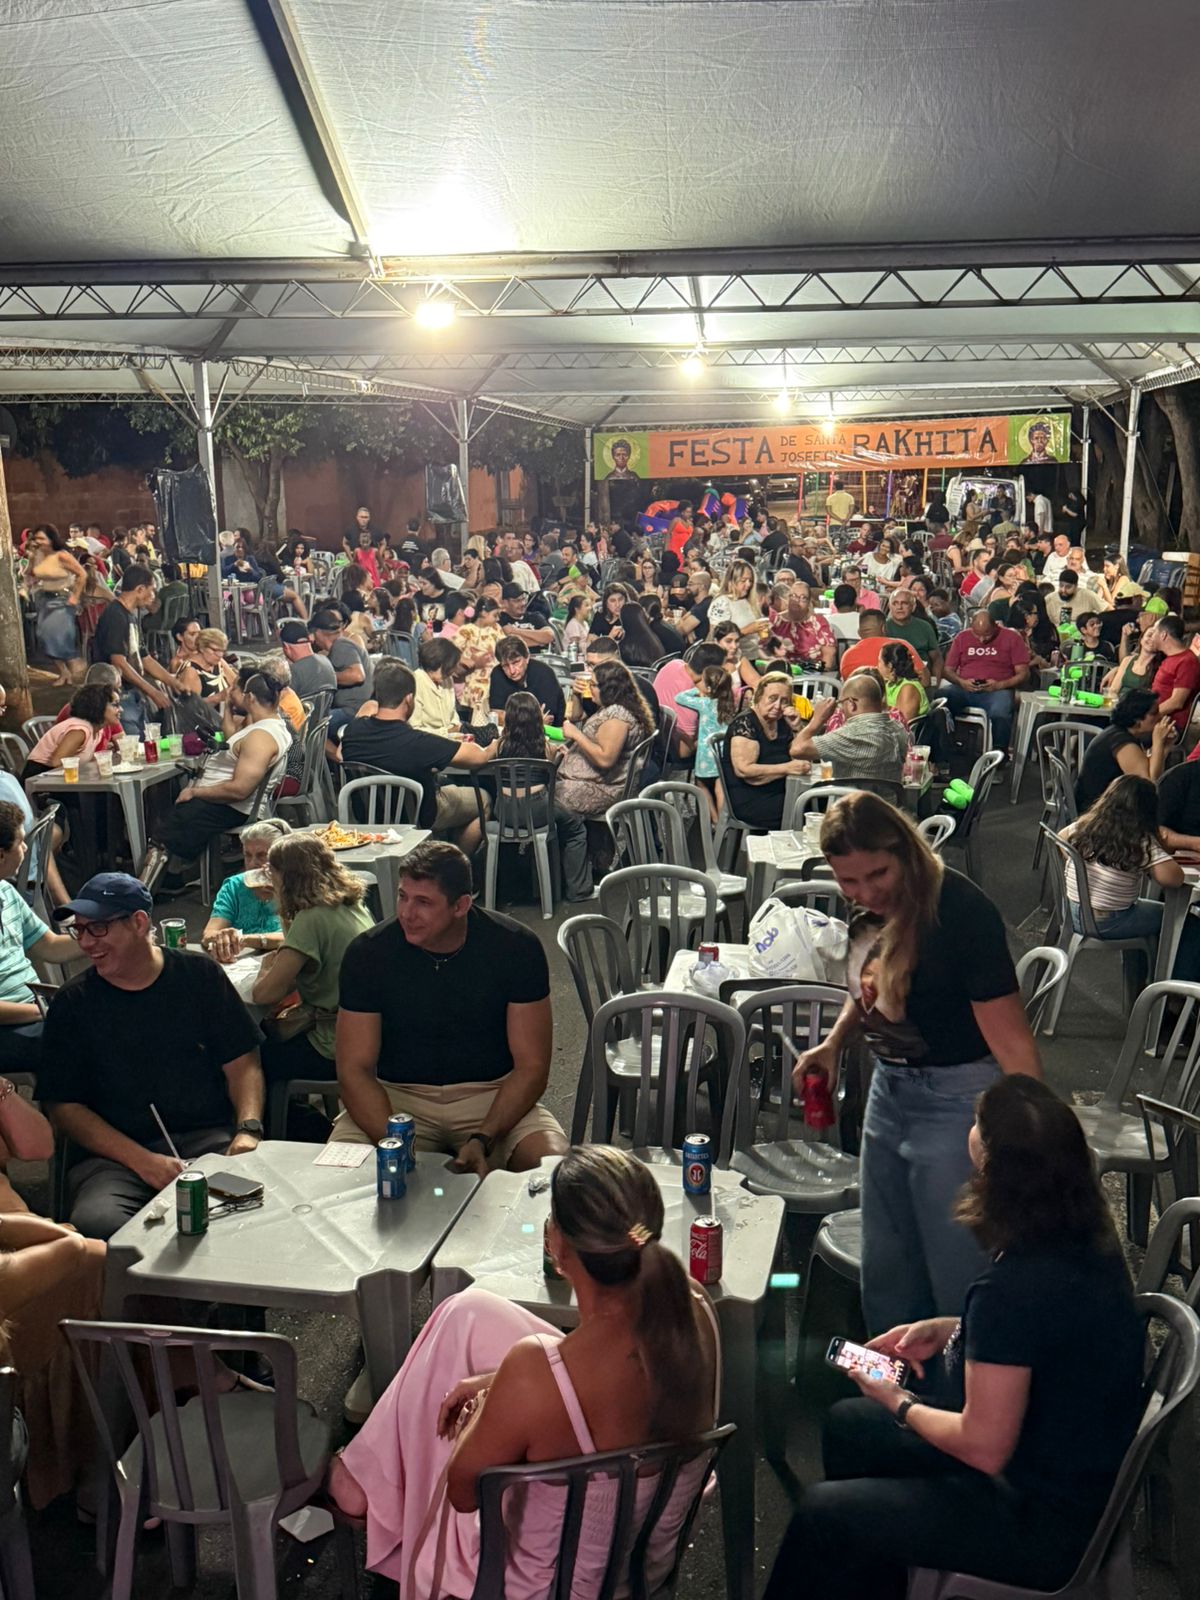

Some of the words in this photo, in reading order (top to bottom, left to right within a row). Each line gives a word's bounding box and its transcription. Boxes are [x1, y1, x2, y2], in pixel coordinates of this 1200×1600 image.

[668, 436, 775, 467] FESTA
[780, 435, 797, 447] DE
[853, 426, 998, 459] BAKHITA
[967, 647, 998, 656] BOSS
